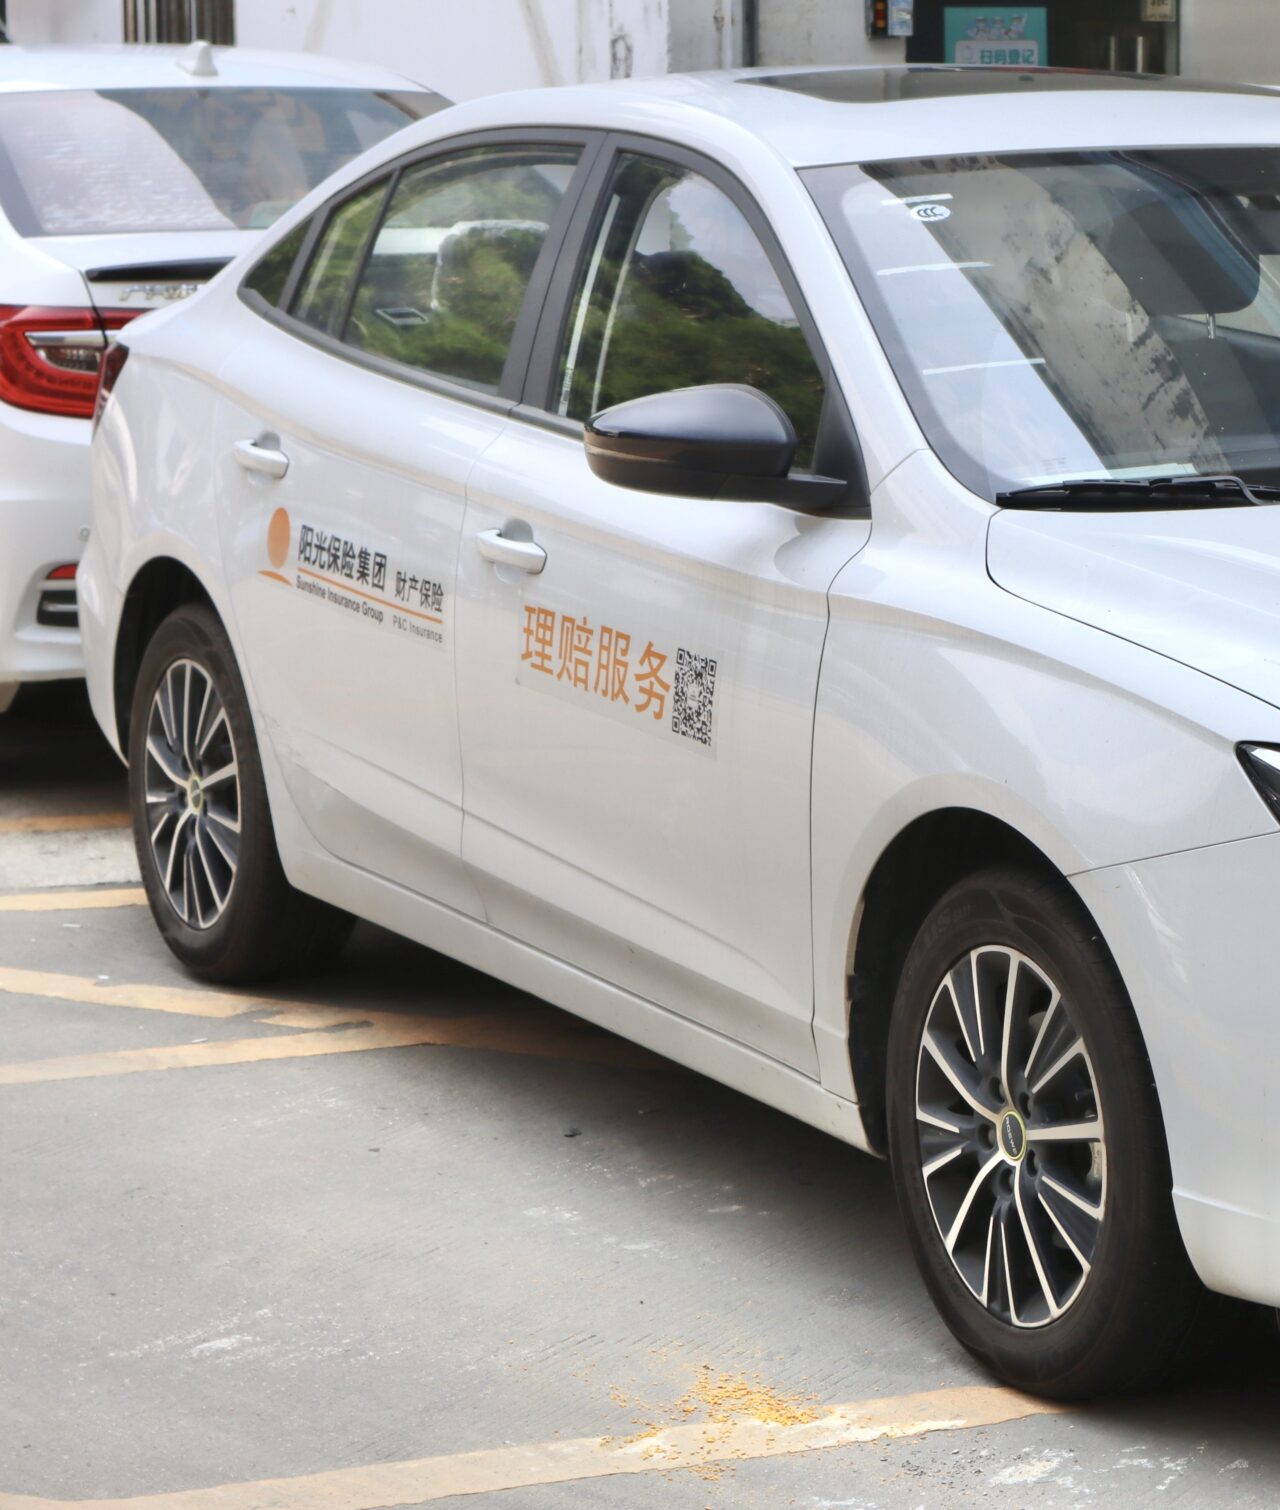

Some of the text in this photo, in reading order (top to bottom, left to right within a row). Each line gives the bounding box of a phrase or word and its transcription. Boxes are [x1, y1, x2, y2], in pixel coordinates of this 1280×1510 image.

[980, 49, 1035, 65] 扫码登记
[298, 524, 444, 613] 阳光保险集团 财产保险
[296, 575, 443, 643] Sunshine Insurance Group P&C Insurance
[521, 605, 671, 721] 理赔服务
